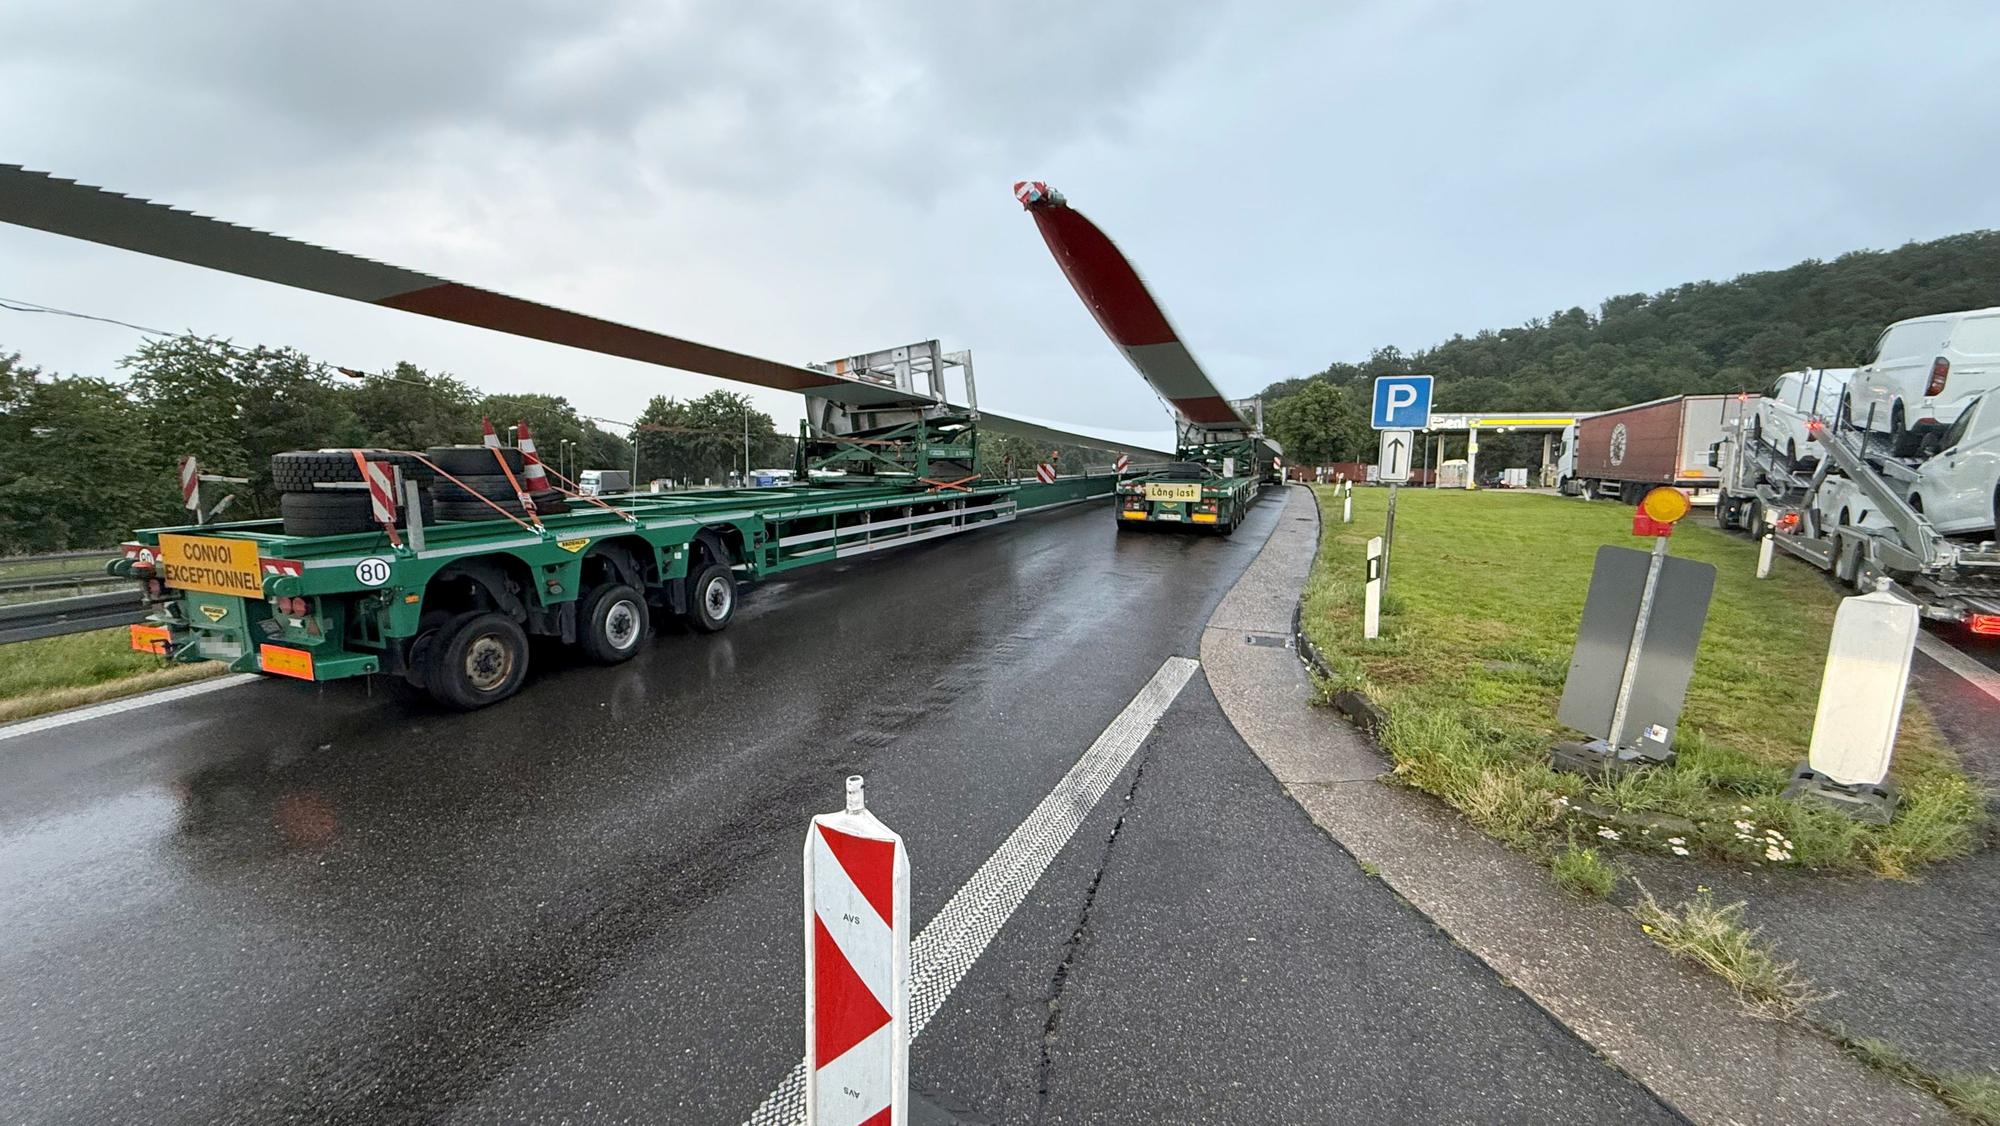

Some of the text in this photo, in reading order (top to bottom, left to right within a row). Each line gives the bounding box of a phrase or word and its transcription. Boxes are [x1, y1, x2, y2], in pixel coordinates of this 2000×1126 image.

[1386, 384, 1417, 422] P
[1152, 488, 1194, 498] Lång last
[183, 543, 232, 564] CONVOI
[165, 564, 260, 591] EXCEPTIONNEL
[361, 563, 386, 582] 80
[843, 913, 860, 925] AVS
[843, 1086, 861, 1099] AVS
